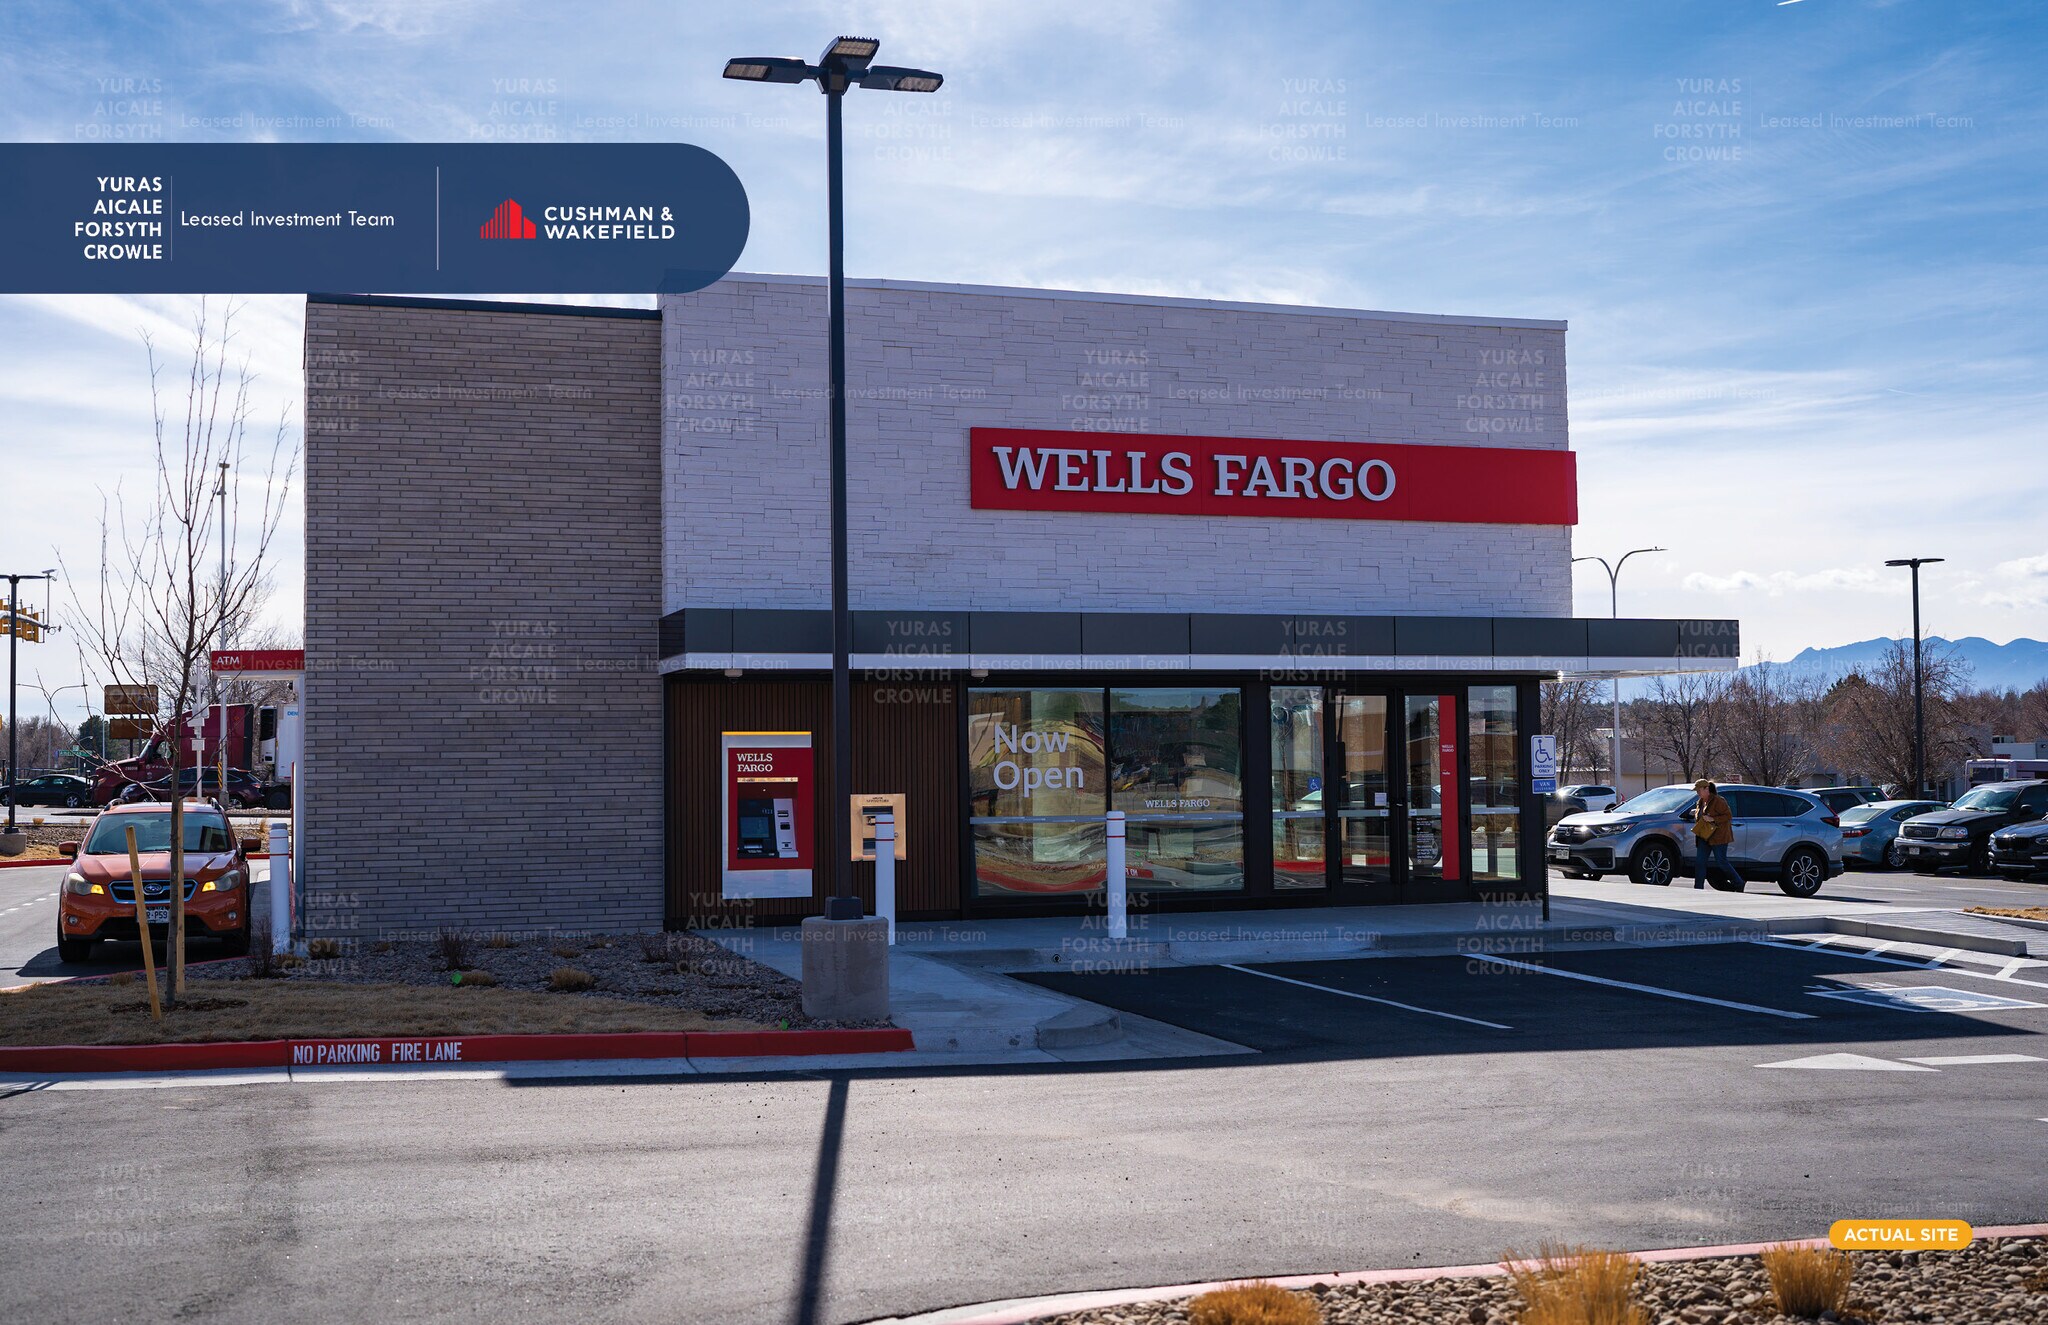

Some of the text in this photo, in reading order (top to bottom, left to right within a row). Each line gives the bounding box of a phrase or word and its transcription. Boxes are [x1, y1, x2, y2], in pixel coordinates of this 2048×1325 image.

[992, 446, 1397, 502] WELLS FARGO
[217, 656, 240, 666] ATM
[994, 723, 1070, 754] Now
[736, 752, 774, 762] WELLS
[736, 763, 774, 773] FARGO
[993, 761, 1084, 798] Open
[1144, 798, 1211, 809] WELLS FARGO
[293, 1042, 463, 1064] NO PARKING FIRE LANE
